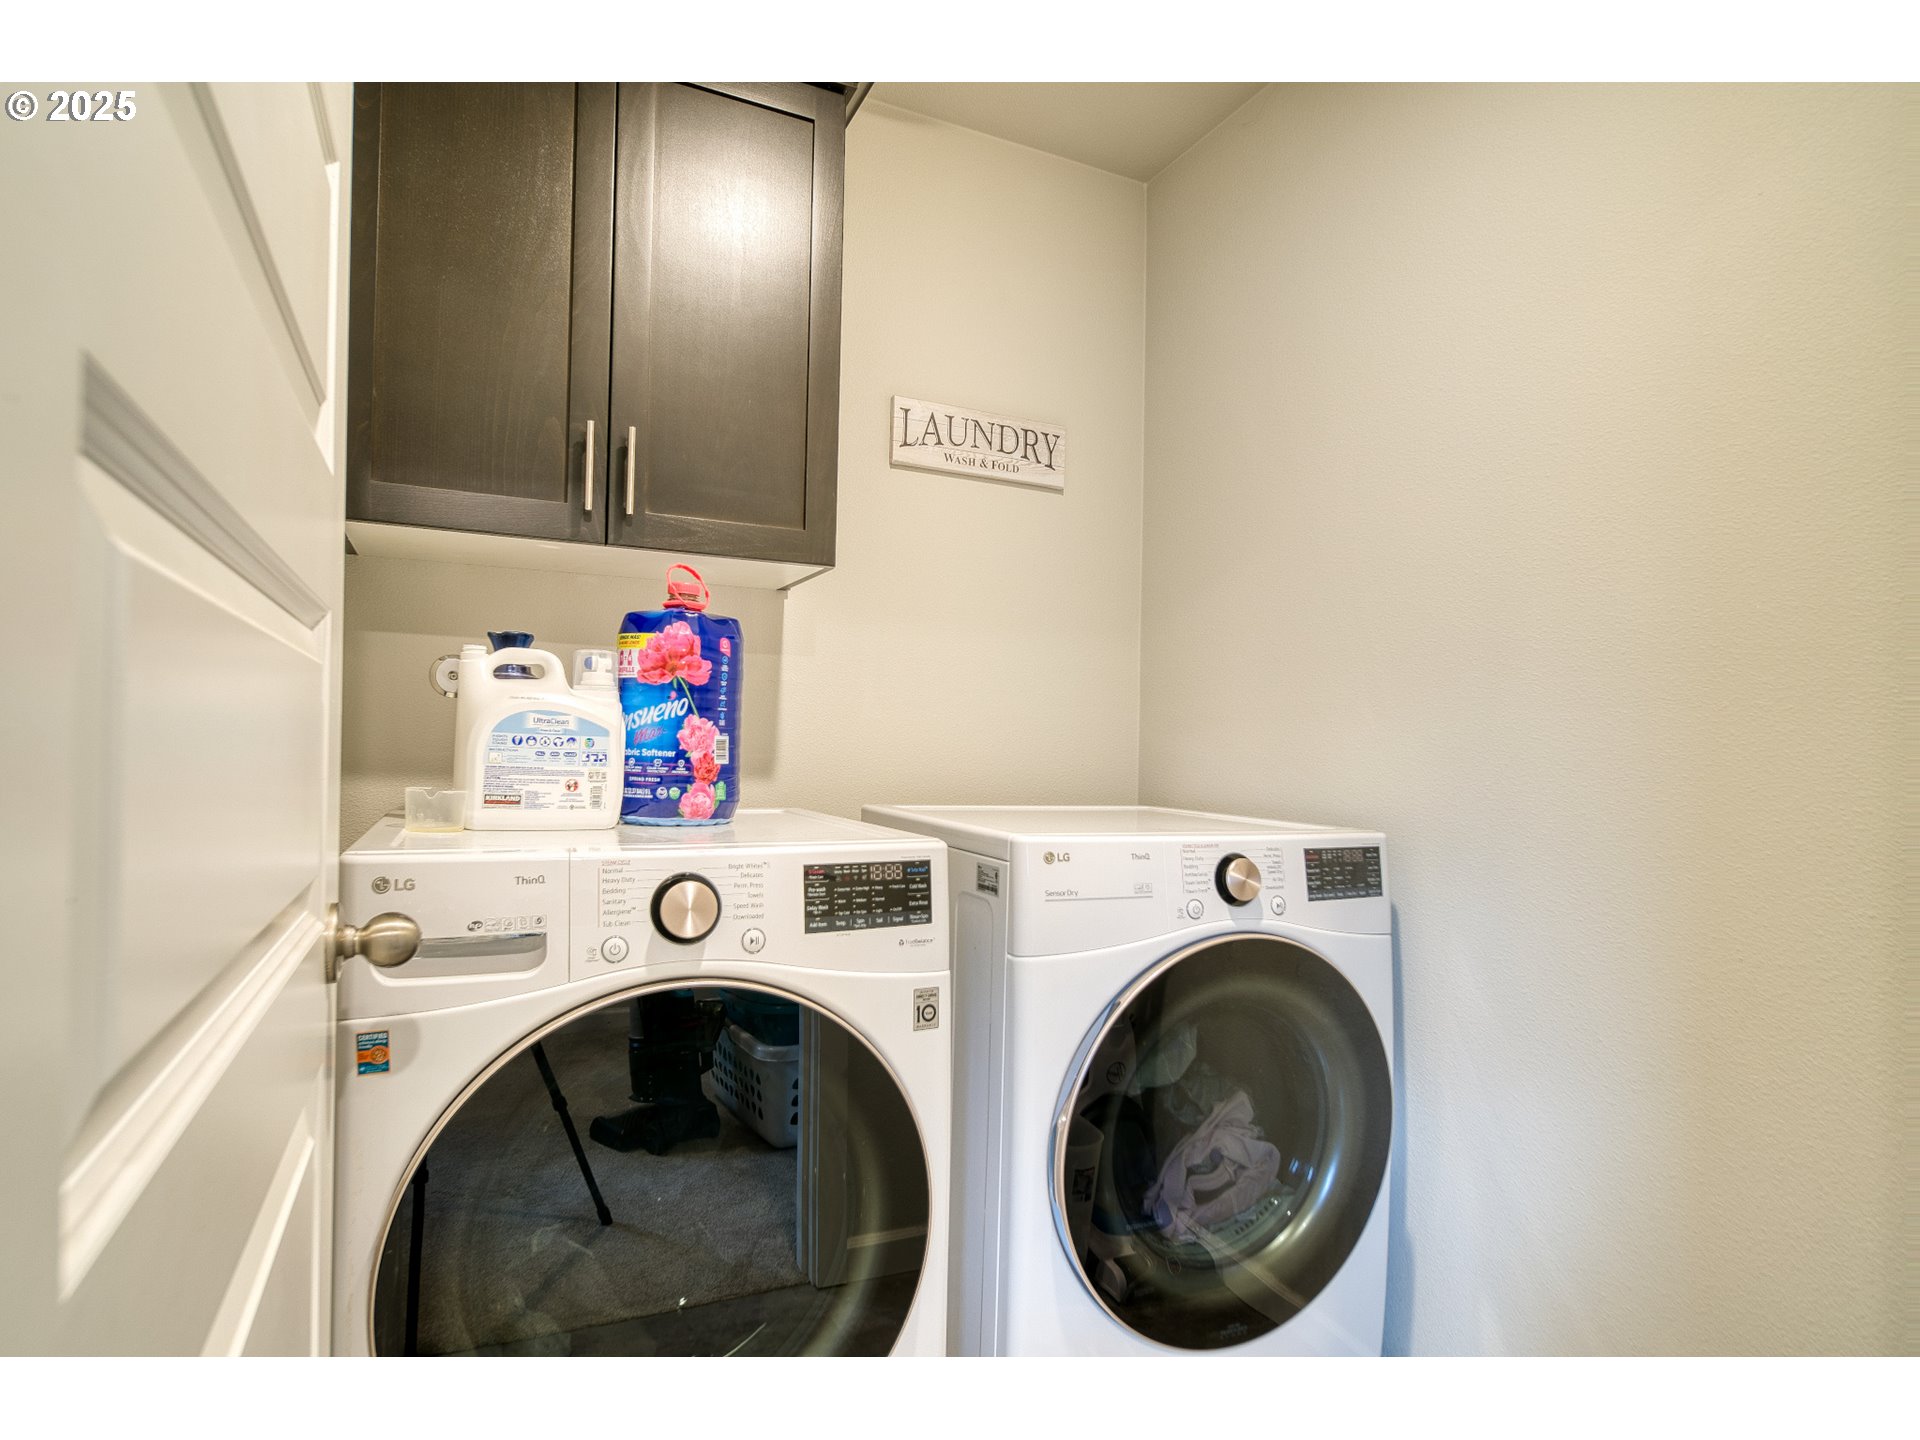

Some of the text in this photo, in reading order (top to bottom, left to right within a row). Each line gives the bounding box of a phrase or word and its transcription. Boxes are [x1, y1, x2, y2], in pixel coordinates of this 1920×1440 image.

[899, 407, 1060, 471] LAUNDRY
[979, 457, 989, 470] &
[533, 716, 569, 725] UltraClean
[625, 748, 676, 757] abric Softener
[1057, 852, 1071, 862] LG
[1131, 852, 1151, 861] ThinQ
[394, 878, 416, 891] LG
[515, 875, 546, 885] ThinQ
[602, 887, 627, 895] Bedding
[1044, 889, 1079, 897] Sensor Dry
